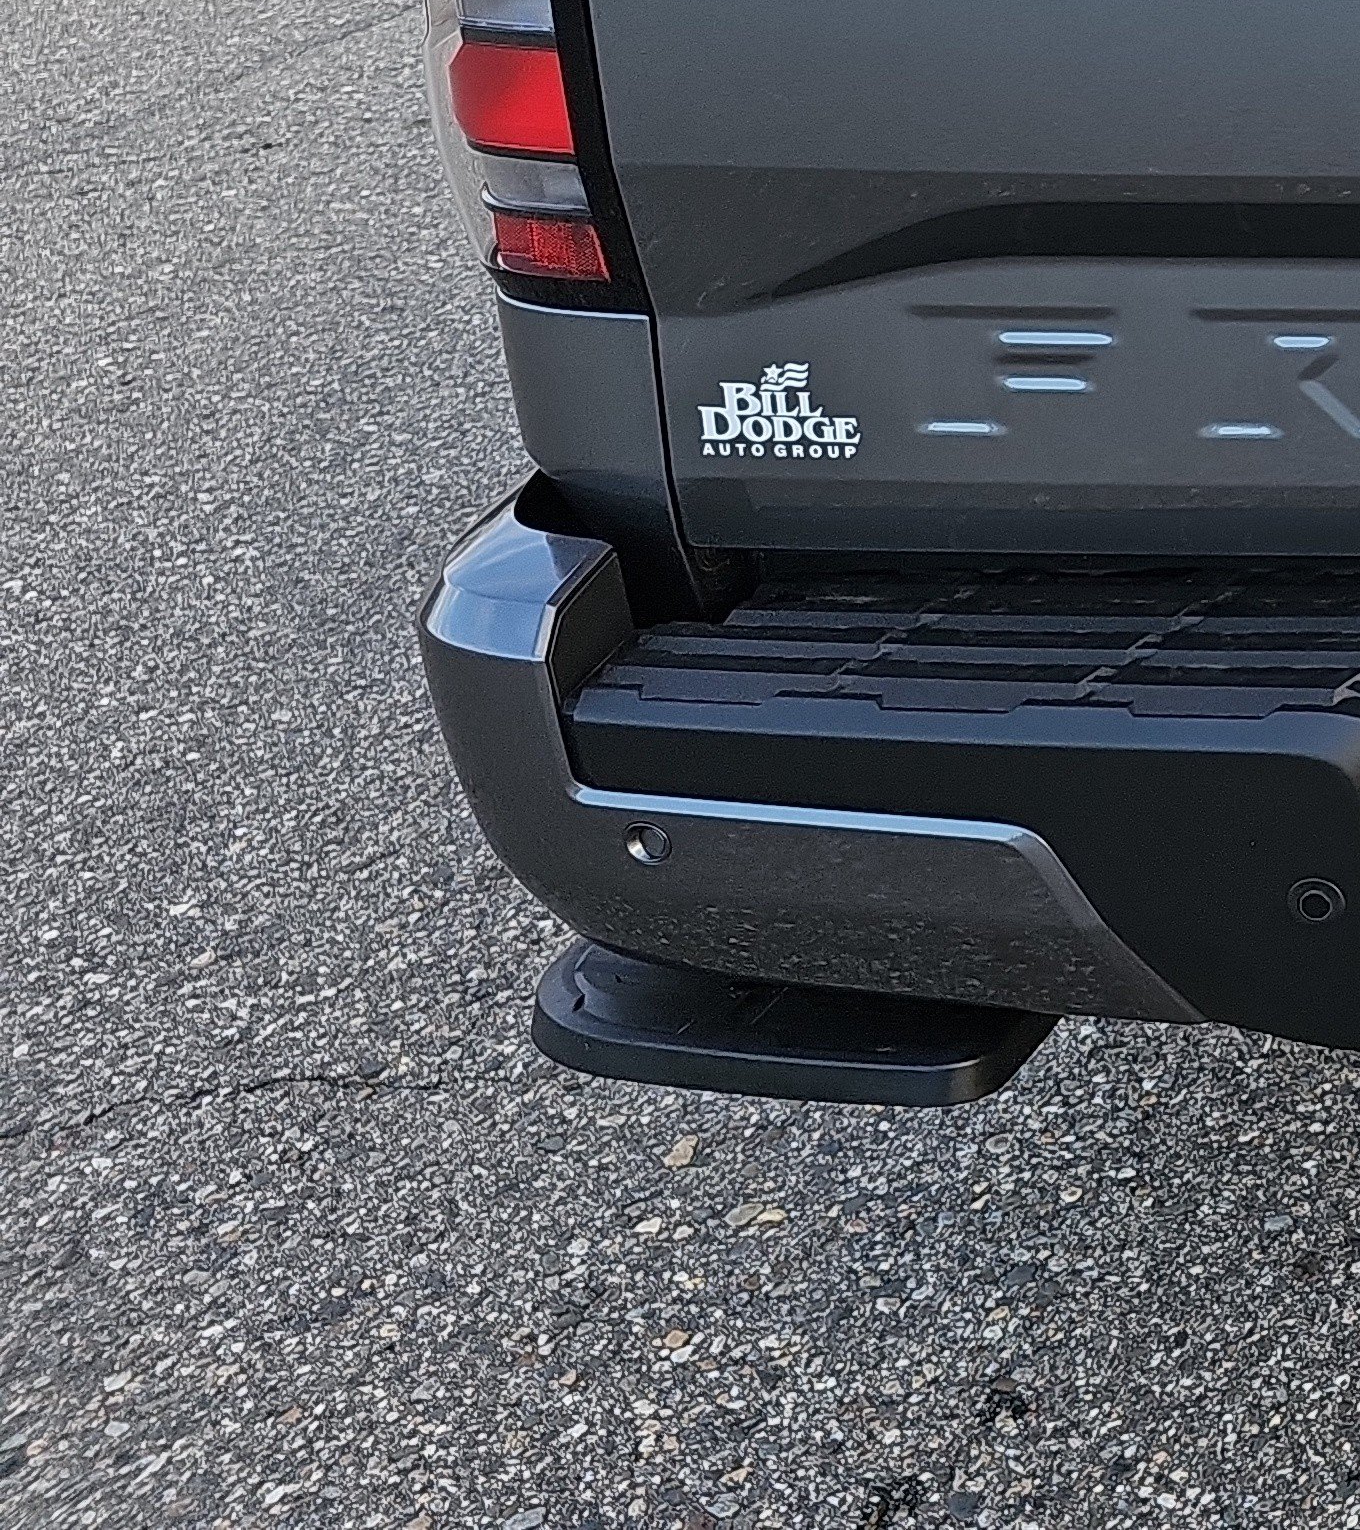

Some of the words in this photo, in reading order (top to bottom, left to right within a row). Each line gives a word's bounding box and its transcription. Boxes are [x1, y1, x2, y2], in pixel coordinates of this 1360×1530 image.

[719, 382, 823, 417] BILL
[698, 406, 861, 444] DODGE
[702, 442, 765, 457] AUTO
[773, 444, 857, 459] GROUP
